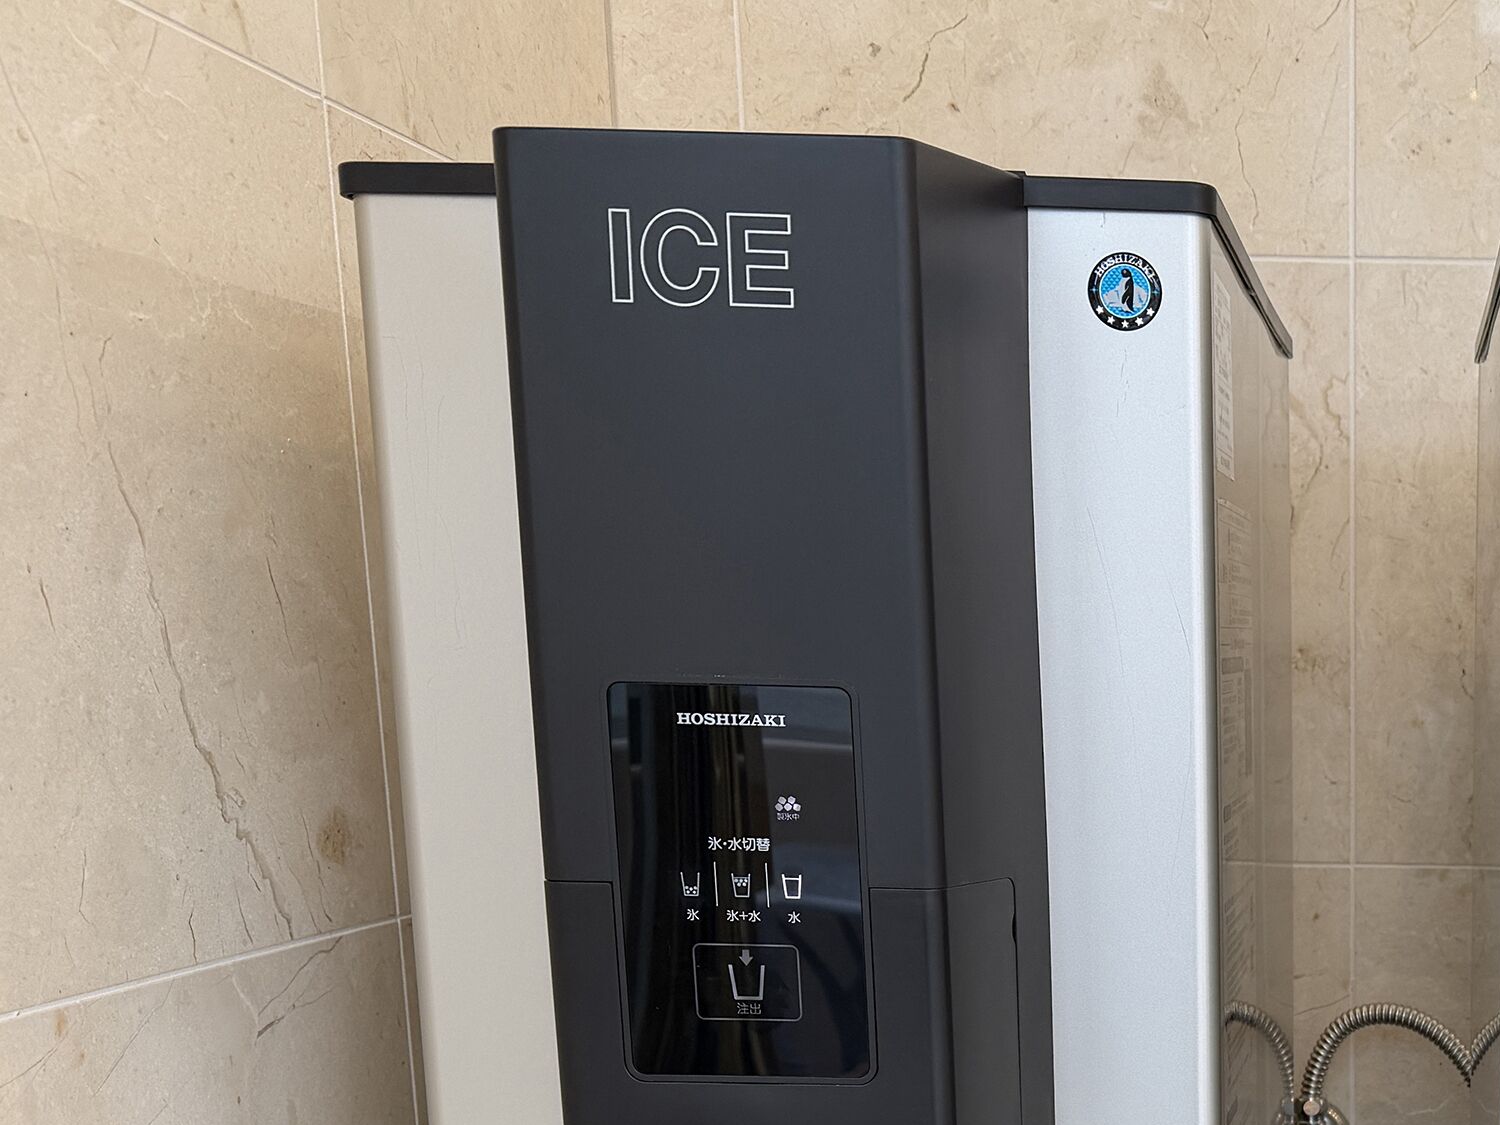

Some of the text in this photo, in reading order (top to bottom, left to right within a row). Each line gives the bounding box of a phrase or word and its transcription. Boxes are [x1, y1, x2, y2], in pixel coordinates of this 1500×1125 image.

[607, 207, 795, 309] ICE
[1094, 253, 1156, 281] HOSHIZAKI
[676, 712, 786, 728] HOSHIZAKI
[686, 908, 802, 924] 氷 氷+水 水
[737, 1002, 762, 1015] 注出
